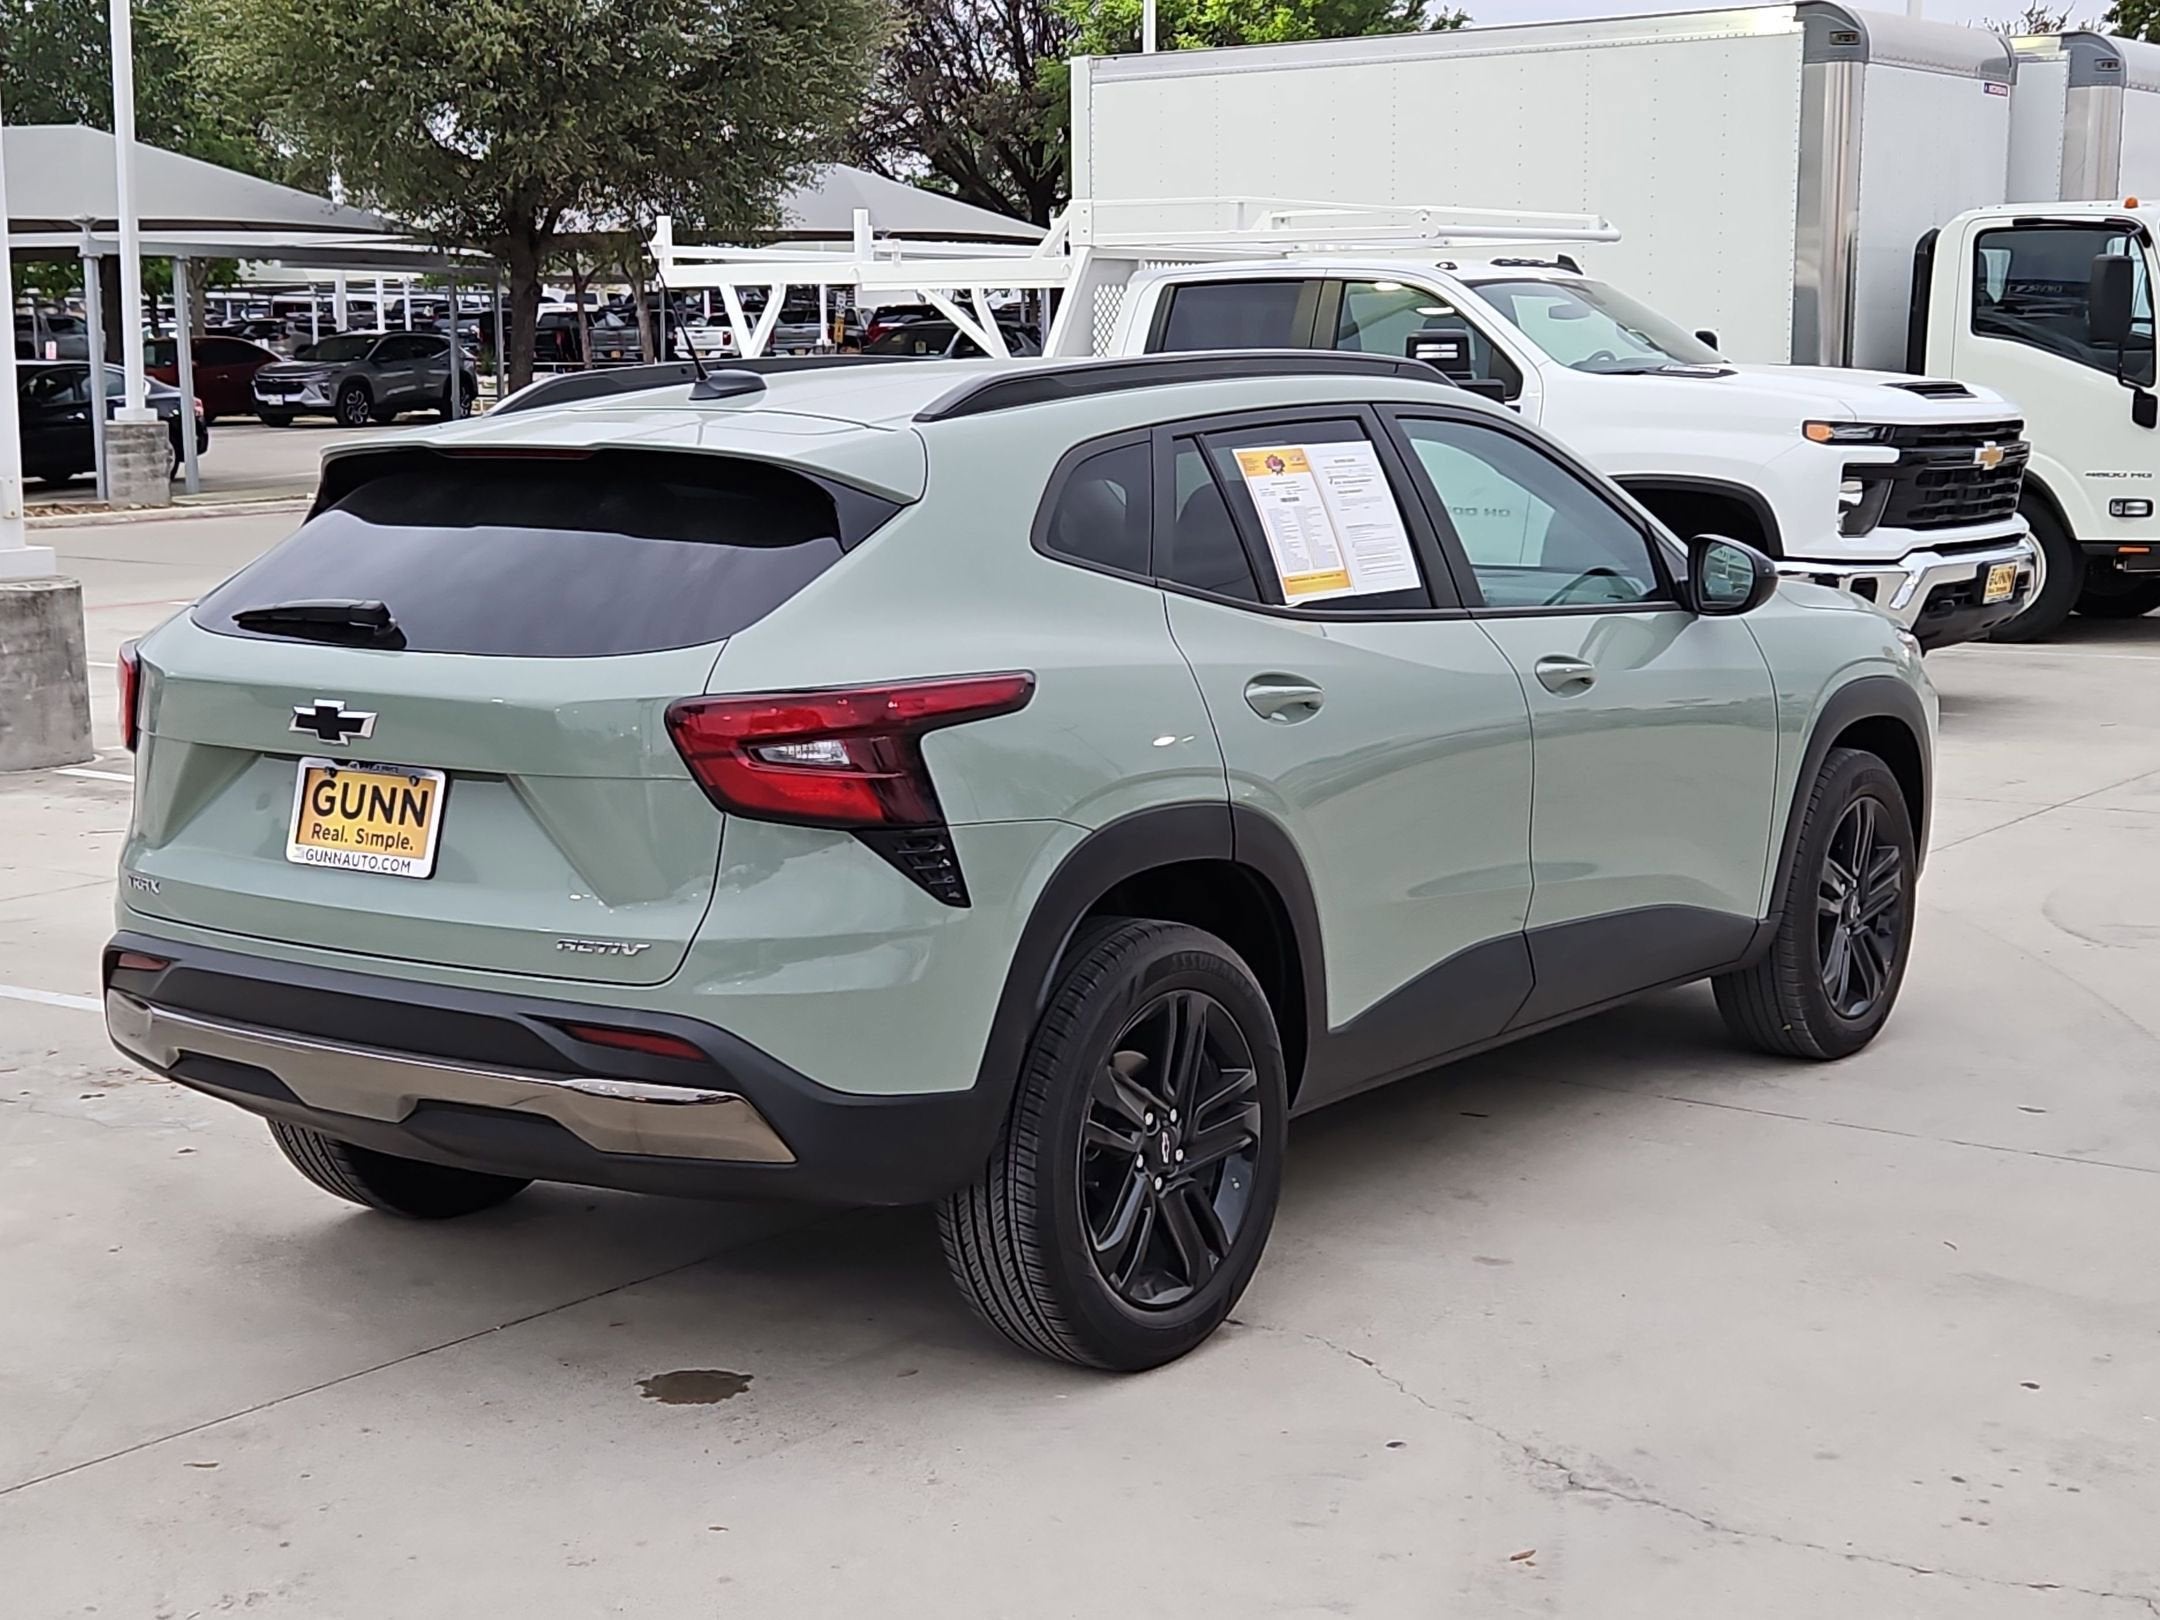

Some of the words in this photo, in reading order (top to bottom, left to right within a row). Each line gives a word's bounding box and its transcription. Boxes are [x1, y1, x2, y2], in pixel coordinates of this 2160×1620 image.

[312, 779, 429, 828] GUNN
[311, 823, 348, 843] Real.
[355, 828, 414, 851] Simple.
[305, 848, 411, 873] GUNNAUTO.COM
[556, 938, 652, 956] ACTIV
